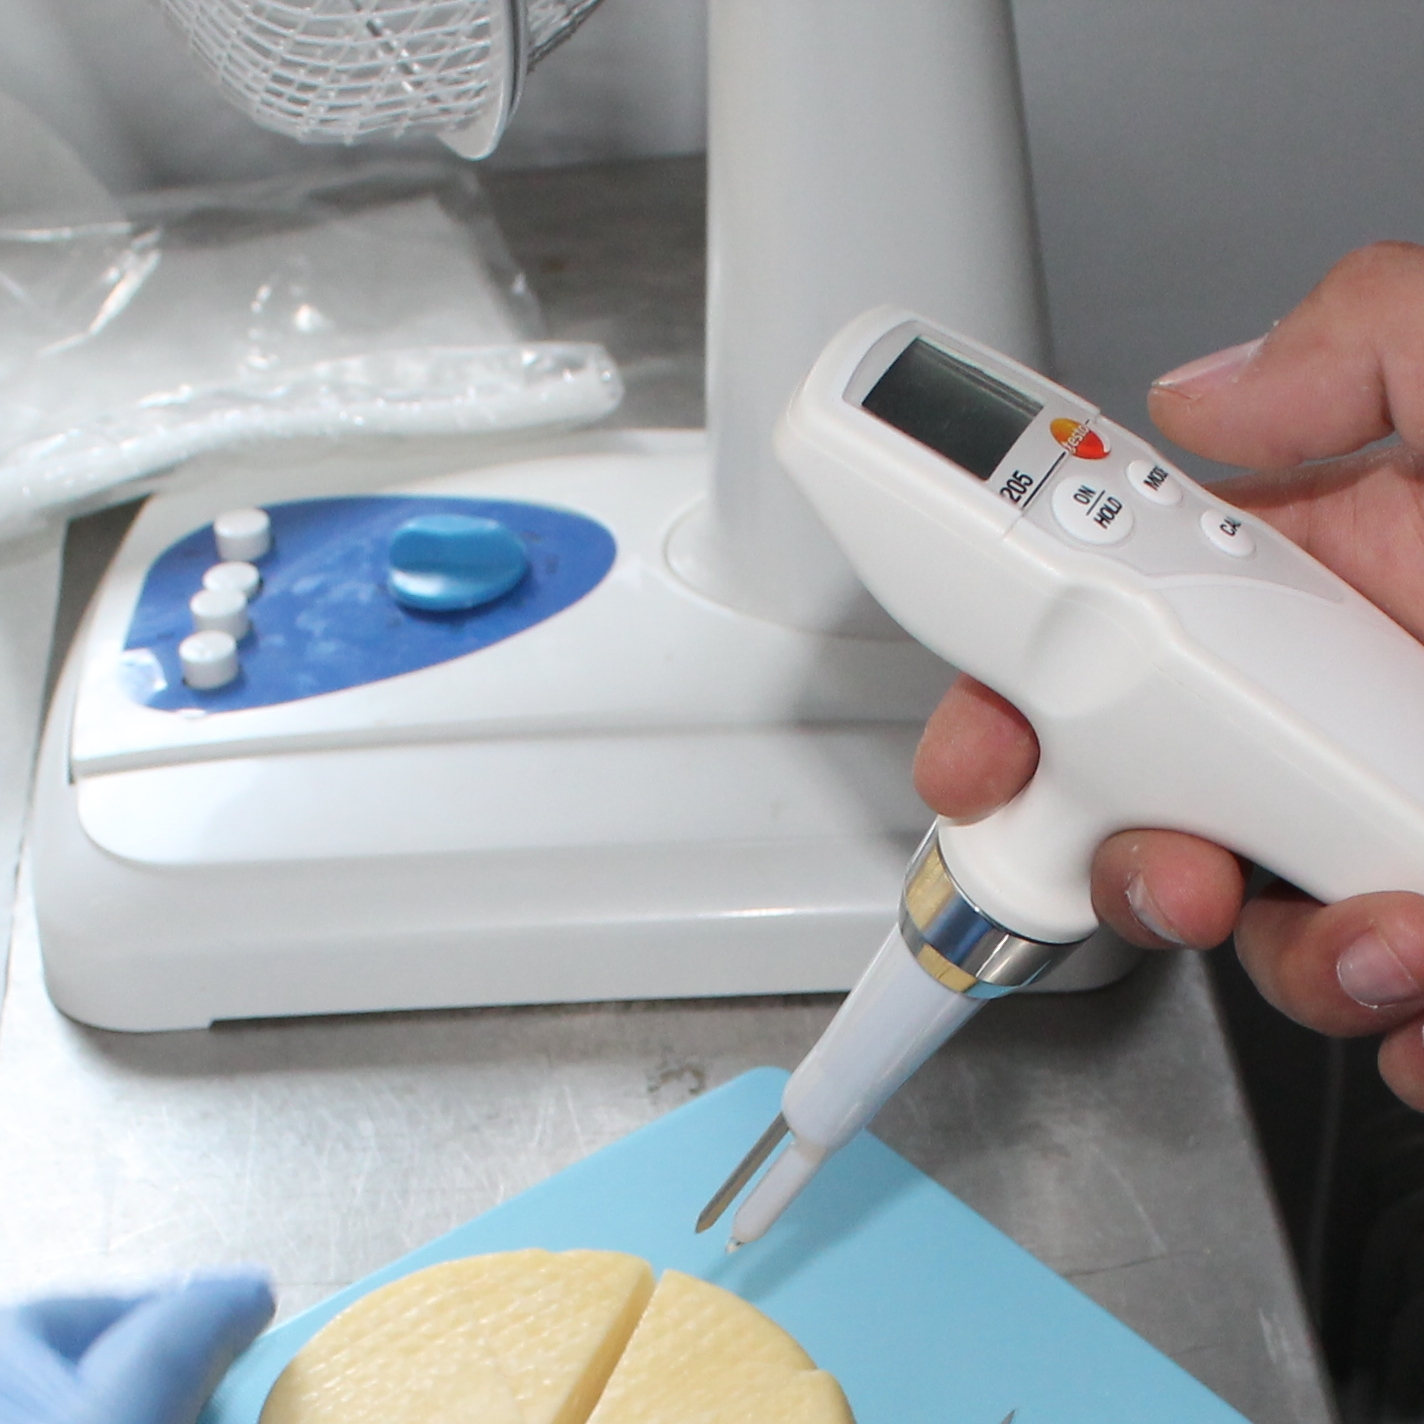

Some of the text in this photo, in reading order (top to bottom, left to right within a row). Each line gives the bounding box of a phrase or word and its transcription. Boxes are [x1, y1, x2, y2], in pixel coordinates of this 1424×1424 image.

[1062, 424, 1089, 455] testo
[1000, 470, 1033, 503] 205
[1073, 484, 1096, 505] ON
[1093, 496, 1123, 529] HOLD
